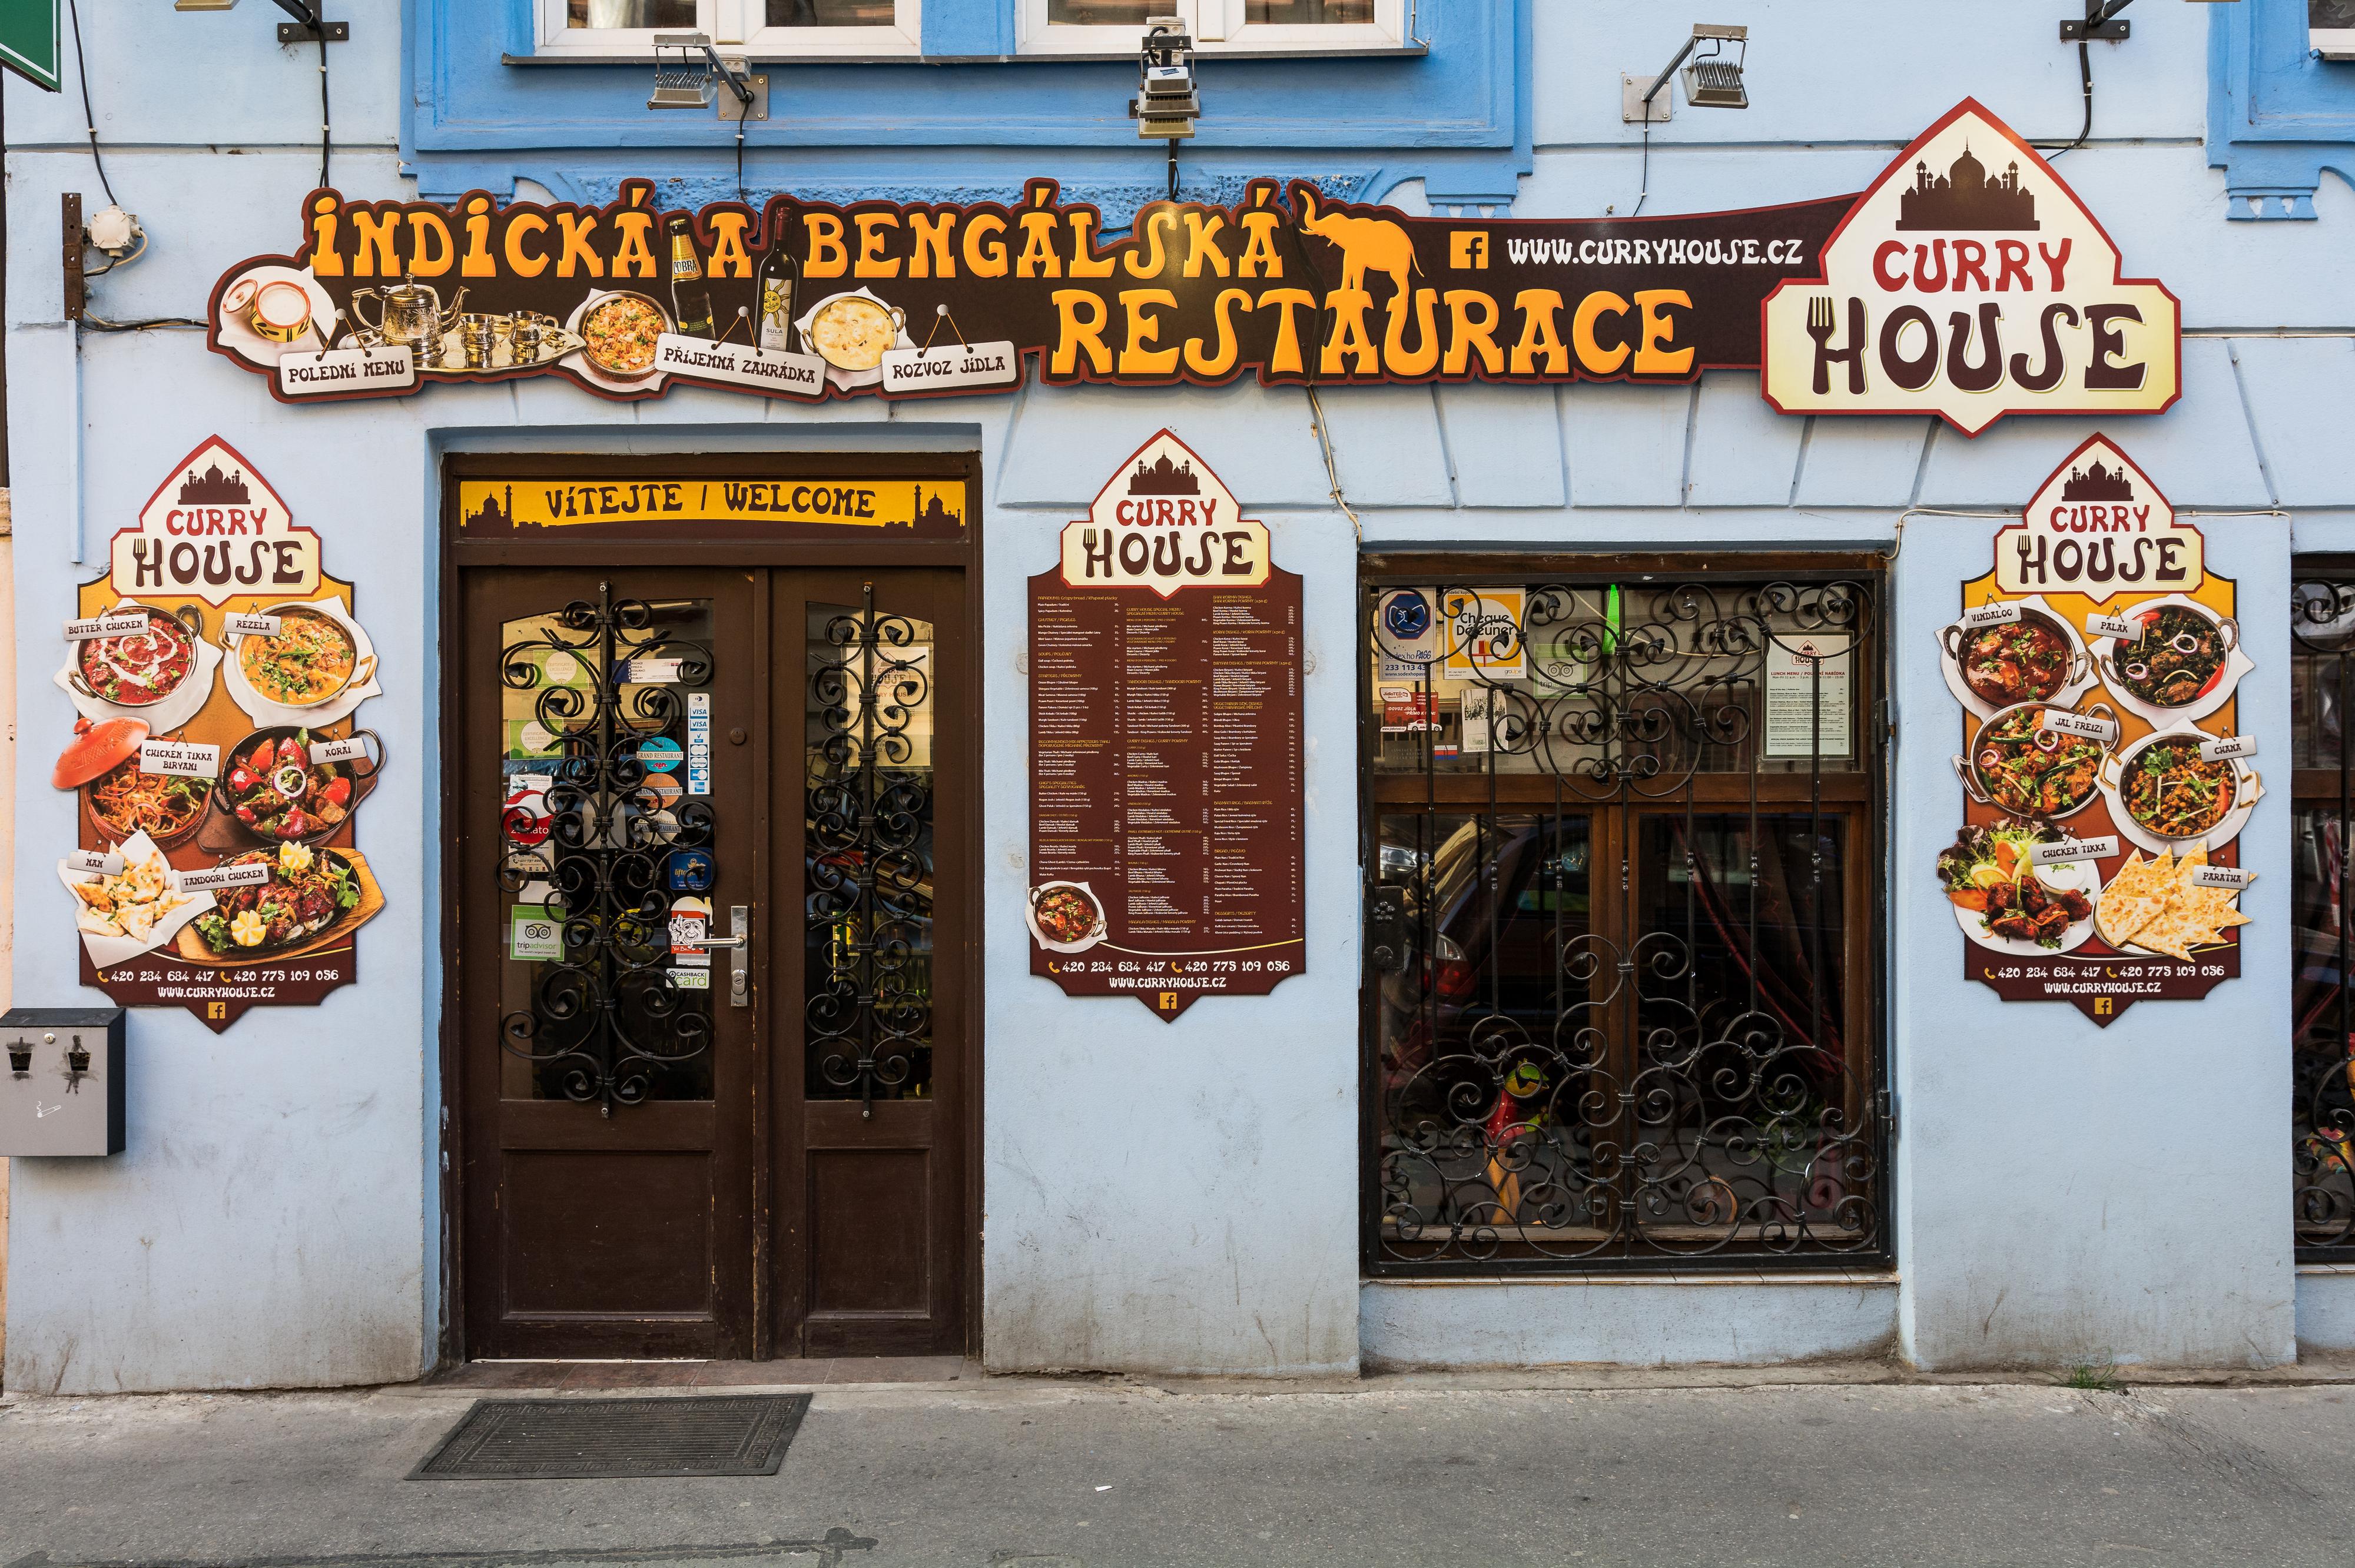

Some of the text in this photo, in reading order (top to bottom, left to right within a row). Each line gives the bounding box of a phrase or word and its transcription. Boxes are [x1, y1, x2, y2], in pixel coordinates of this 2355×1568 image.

[708, 212, 753, 278] A
[802, 188, 1284, 280] BENGÁLSKÁ
[1507, 238, 1803, 265] WWW.CURRYHOUSE.CZ
[674, 259, 698, 274] COBRA
[1873, 237, 2072, 293] CURRY
[1051, 288, 1696, 377] RESTAURACE
[1806, 296, 2148, 396] HOUSE
[364, 359, 405, 377] MENU
[741, 359, 816, 384] ZAHRÁDKA
[893, 360, 953, 381] ROZVOZ
[700, 484, 708, 511] /
[723, 482, 876, 518] WELCOME
[1116, 498, 1217, 526] CURRY
[2050, 504, 2150, 533] CURRY
[166, 507, 268, 536] CURRY
[1082, 528, 1255, 578] HOUSE
[2016, 534, 2187, 584] HOUSE
[132, 538, 305, 587] HOUSE
[68, 623, 102, 635] BUTTER
[236, 619, 271, 632] REZELA
[1457, 624, 1514, 636] Déeuner
[2101, 621, 2128, 633] PALAK
[2055, 717, 2071, 729] JAL
[2214, 743, 2241, 755] CHANA
[85, 858, 104, 869] NAN
[2203, 871, 2241, 883] PARATHA
[1062, 961, 1166, 972] 420 284 684 417
[1185, 961, 1289, 972] 420 775 109 056
[1998, 966, 2101, 979] 420 284 684 417
[2120, 966, 2225, 979] 420 775 109 056
[111, 970, 215, 982] 420 284 684 417
[233, 970, 339, 982] 420 775 109 056
[675, 973, 706, 986] card
[1109, 977, 1226, 989] WWW.CURRYHOUSE.CZ
[2044, 982, 2162, 994] WWW.CURRYHOUSE.CZ
[157, 986, 275, 999] WWW.CURRYHOUSE.CZ
